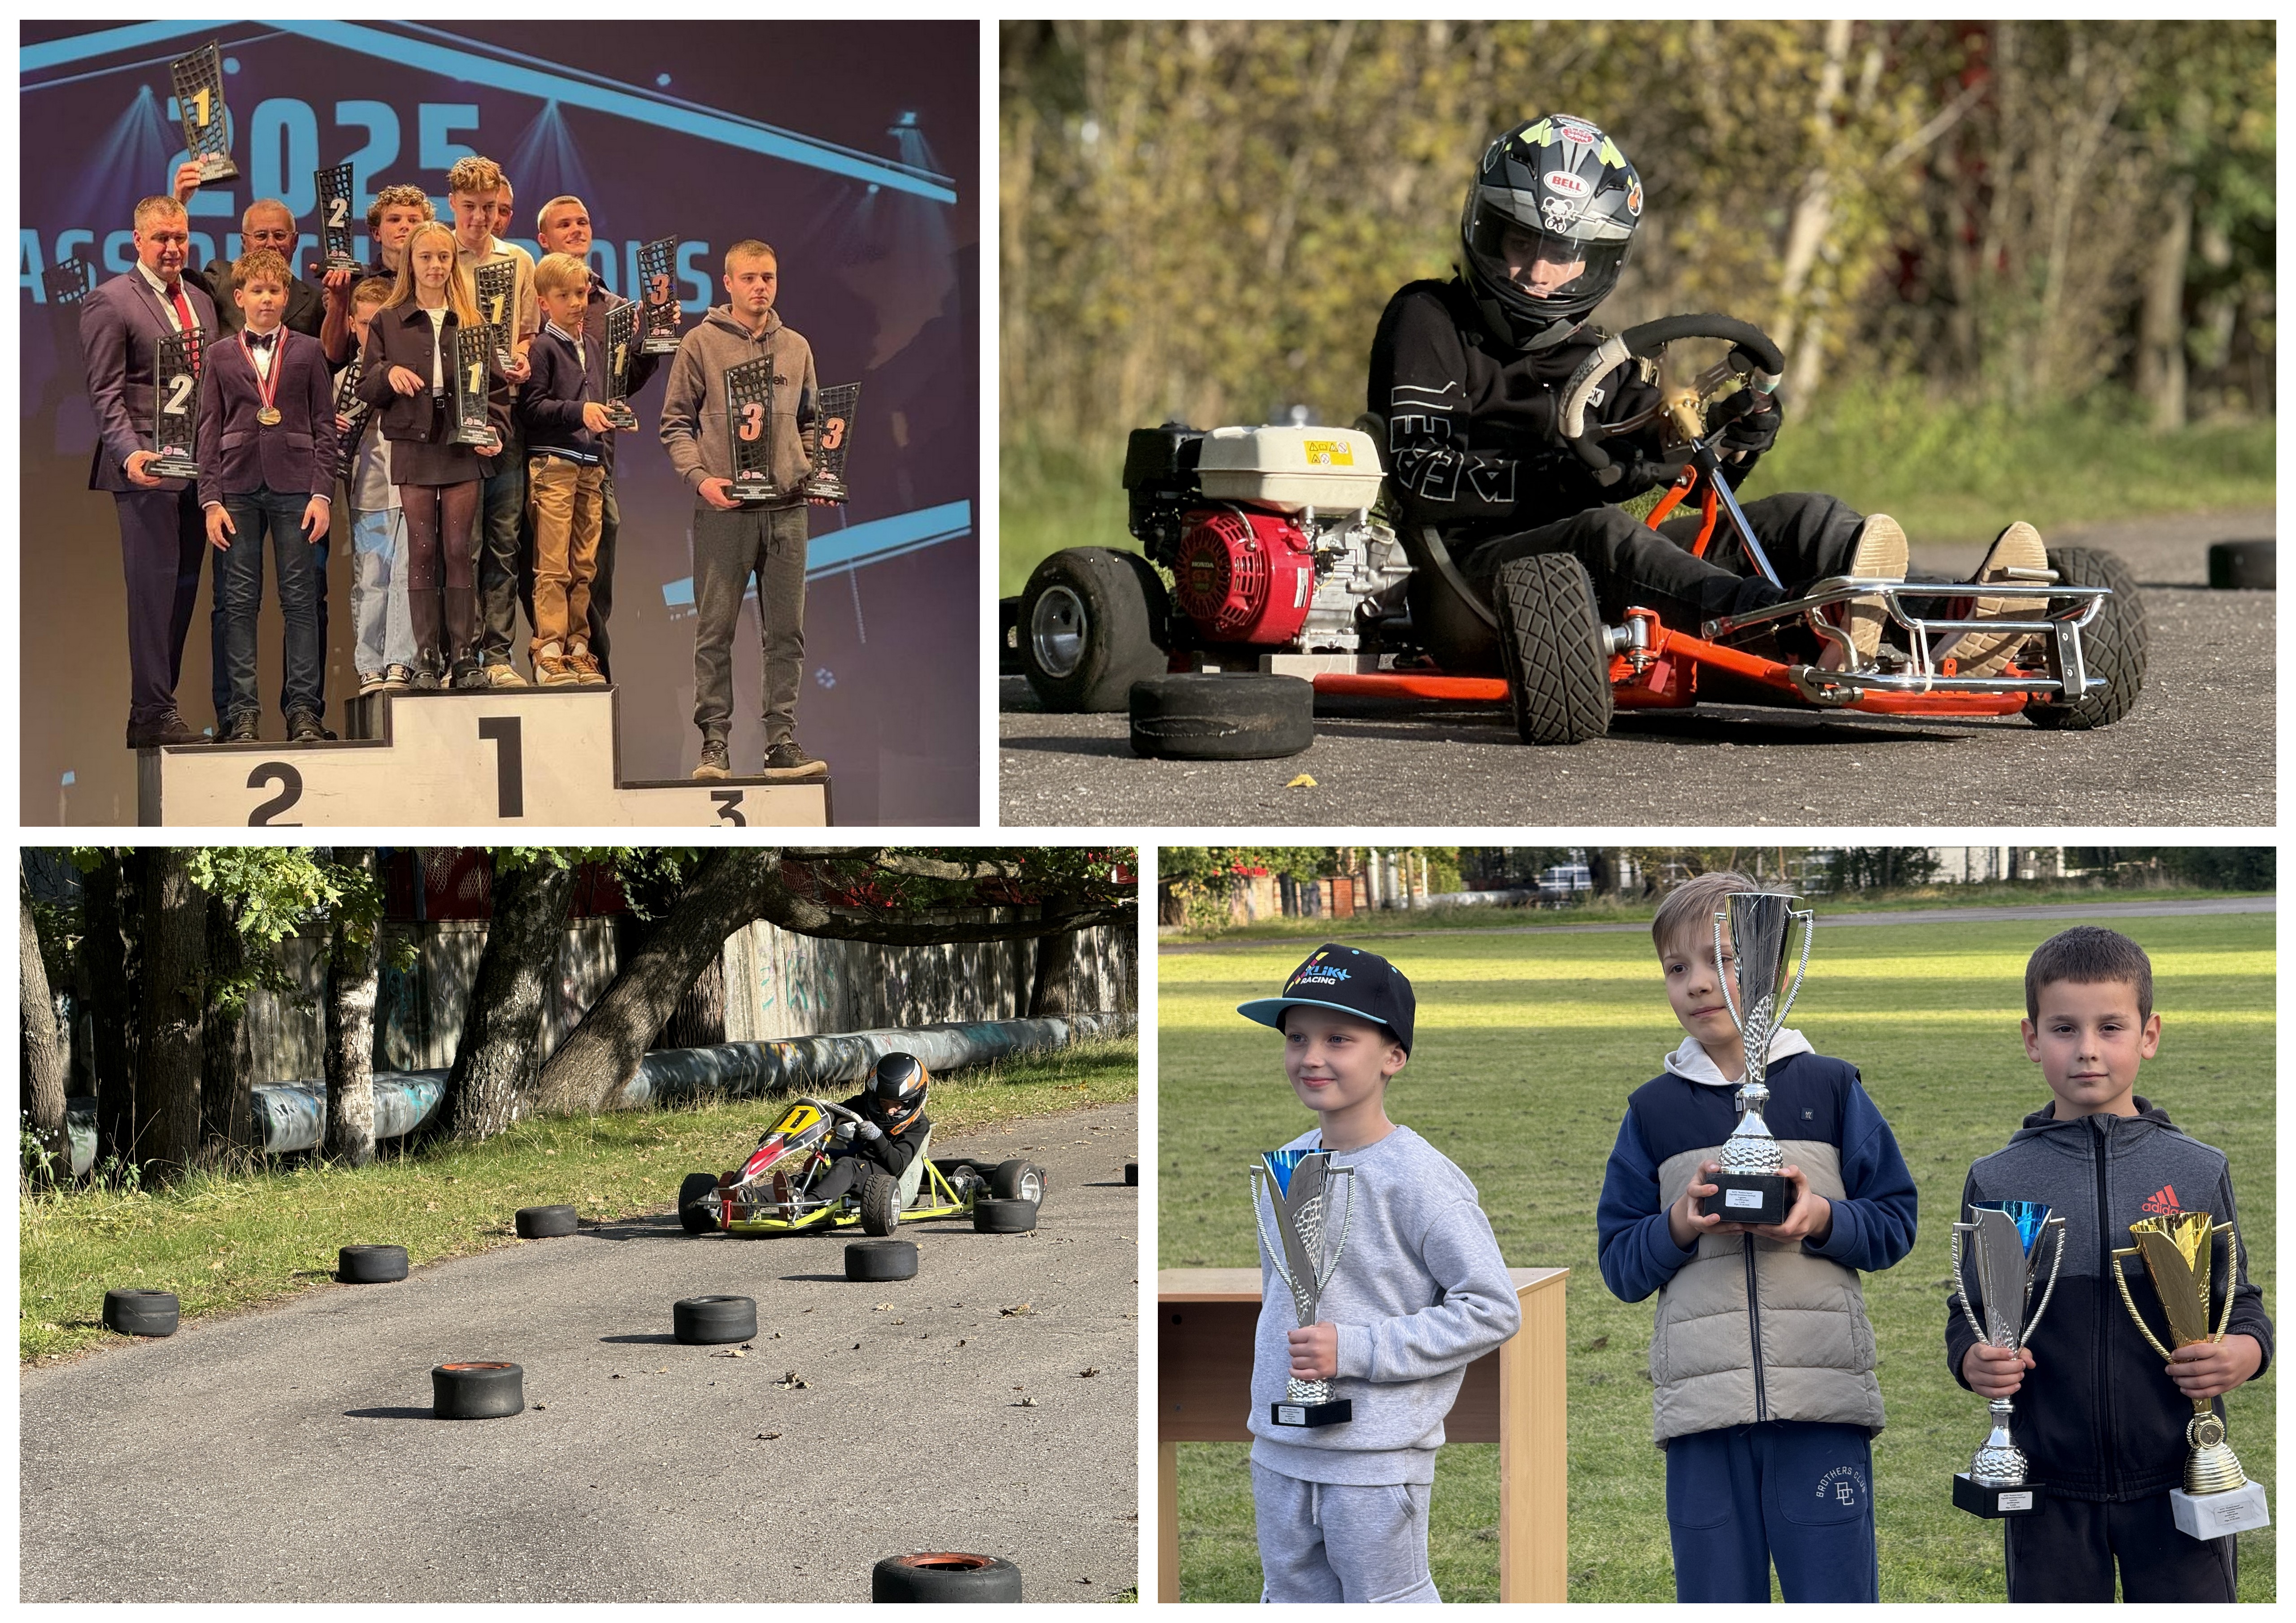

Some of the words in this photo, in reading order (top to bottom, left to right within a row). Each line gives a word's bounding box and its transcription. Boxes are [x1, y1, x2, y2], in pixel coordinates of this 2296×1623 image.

[191, 87, 210, 127] 1
[167, 95, 481, 221] 2025
[1552, 175, 1582, 192] BELL
[329, 199, 348, 227] 2
[650, 273, 670, 305] 3
[491, 294, 506, 324] 1
[613, 343, 626, 376] 1
[164, 373, 194, 414] 2
[468, 361, 483, 394] 1
[740, 402, 765, 441] 3
[822, 417, 845, 449] 3
[478, 716, 523, 818] 1
[247, 762, 303, 827] 2
[710, 790, 746, 827] 3
[1300, 976, 1336, 985] RACING
[828, 1102, 853, 1115] KOSMIC
[2142, 1202, 2186, 1215] adida
[1816, 1466, 1852, 1497] BROTHERS
[1853, 1471, 1866, 1493] CLUB
